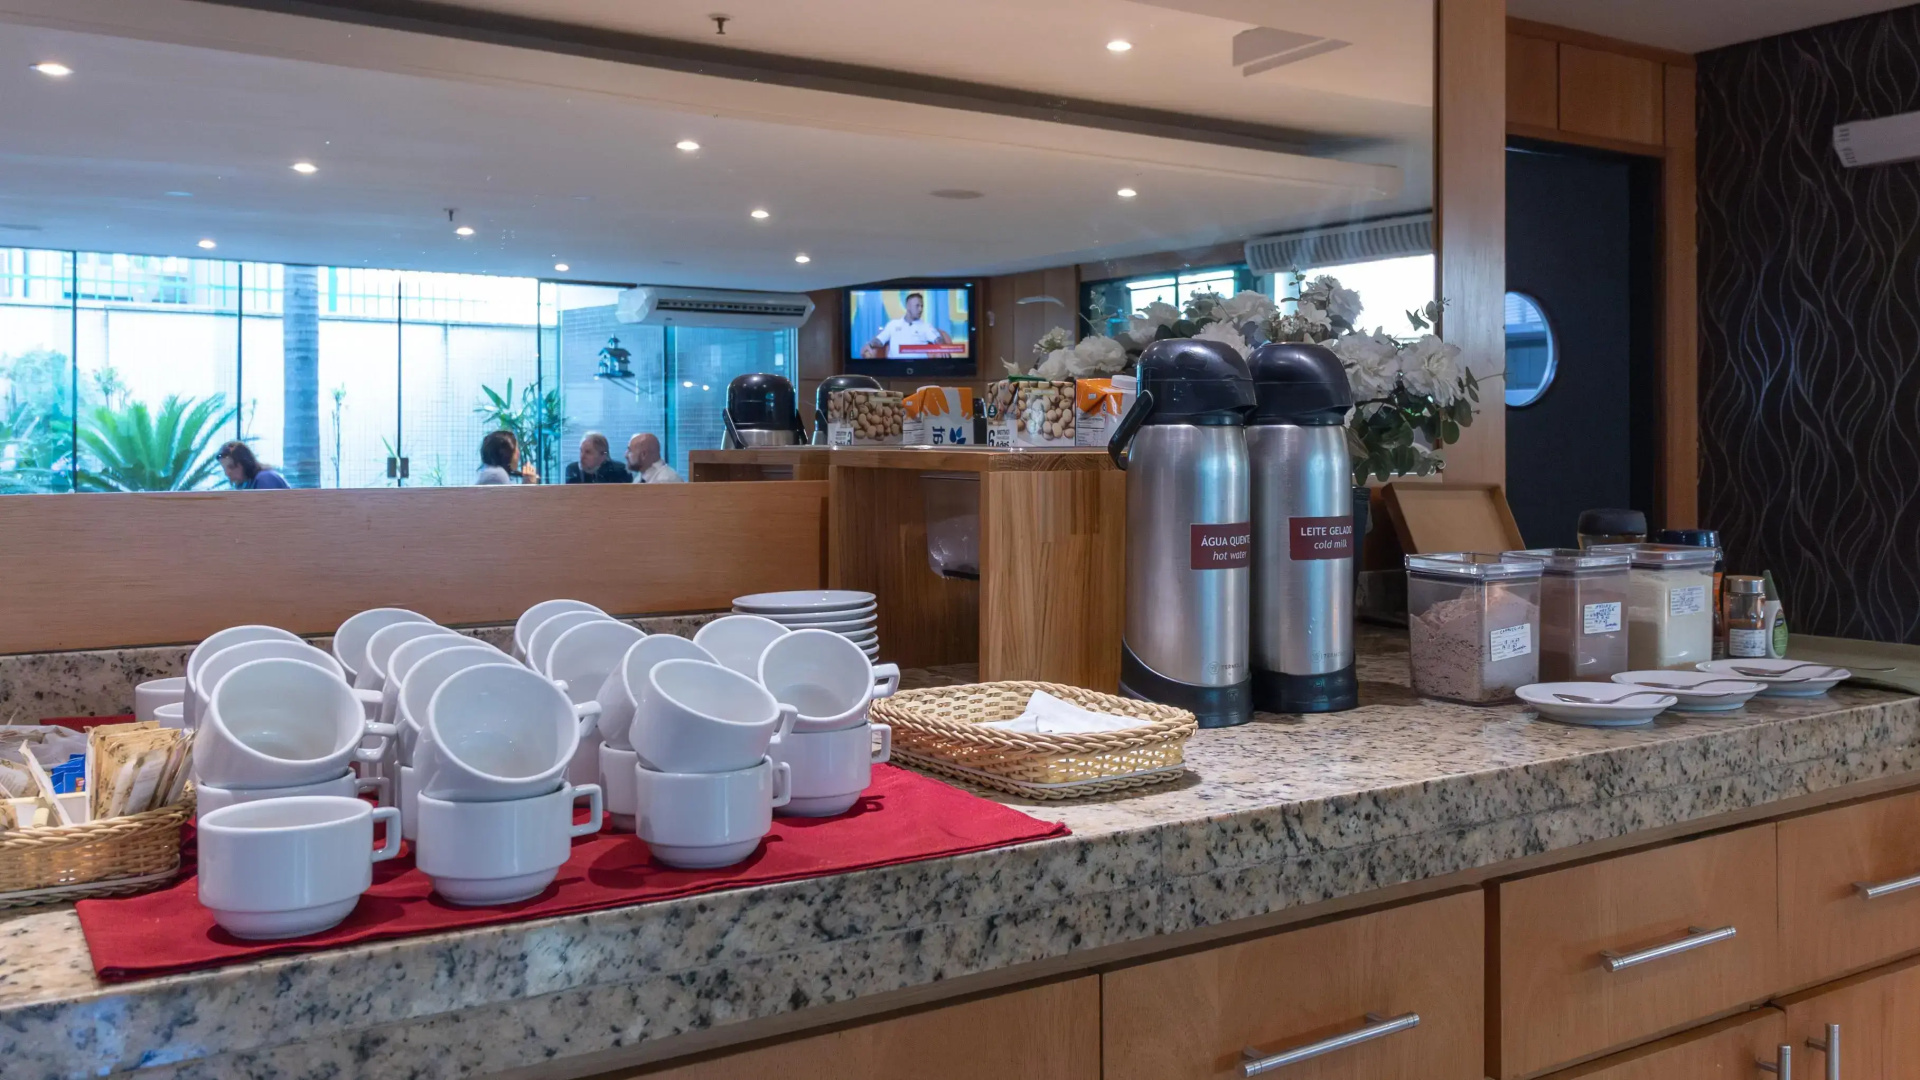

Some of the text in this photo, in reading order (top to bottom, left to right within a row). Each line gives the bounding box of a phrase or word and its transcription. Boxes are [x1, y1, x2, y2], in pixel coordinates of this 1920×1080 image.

[1300, 526, 1327, 537] LEITE
[1201, 534, 1228, 547] ÁGUA
[1314, 539, 1347, 550] cold milk
[1213, 550, 1247, 561] hot water
